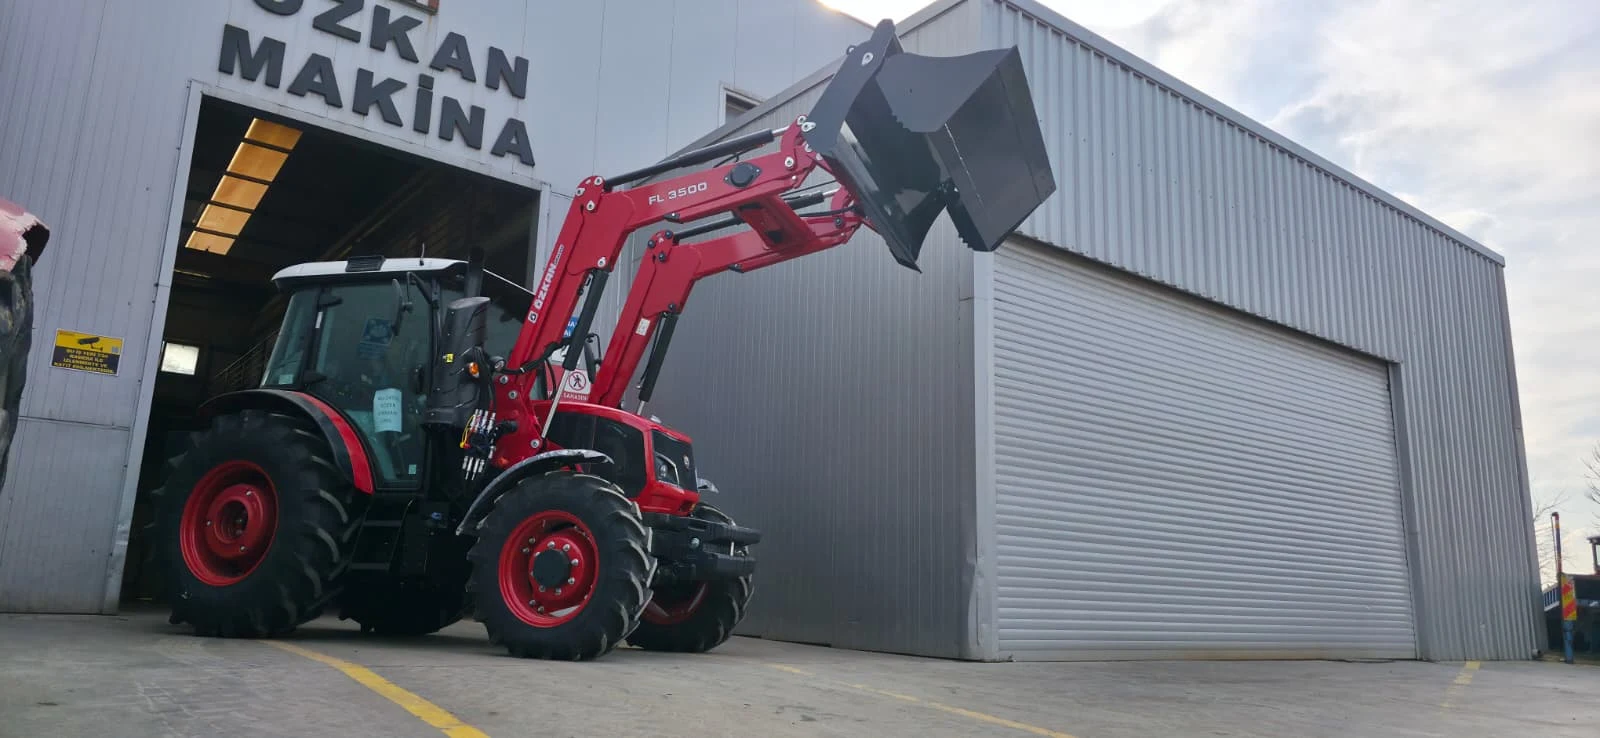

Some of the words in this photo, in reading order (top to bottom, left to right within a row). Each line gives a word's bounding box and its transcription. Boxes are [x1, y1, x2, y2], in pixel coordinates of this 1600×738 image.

[218, 24, 535, 167] MAKİNA
[255, 0, 529, 99] ZKAN
[648, 194, 664, 206] FL
[668, 181, 708, 200] 3500
